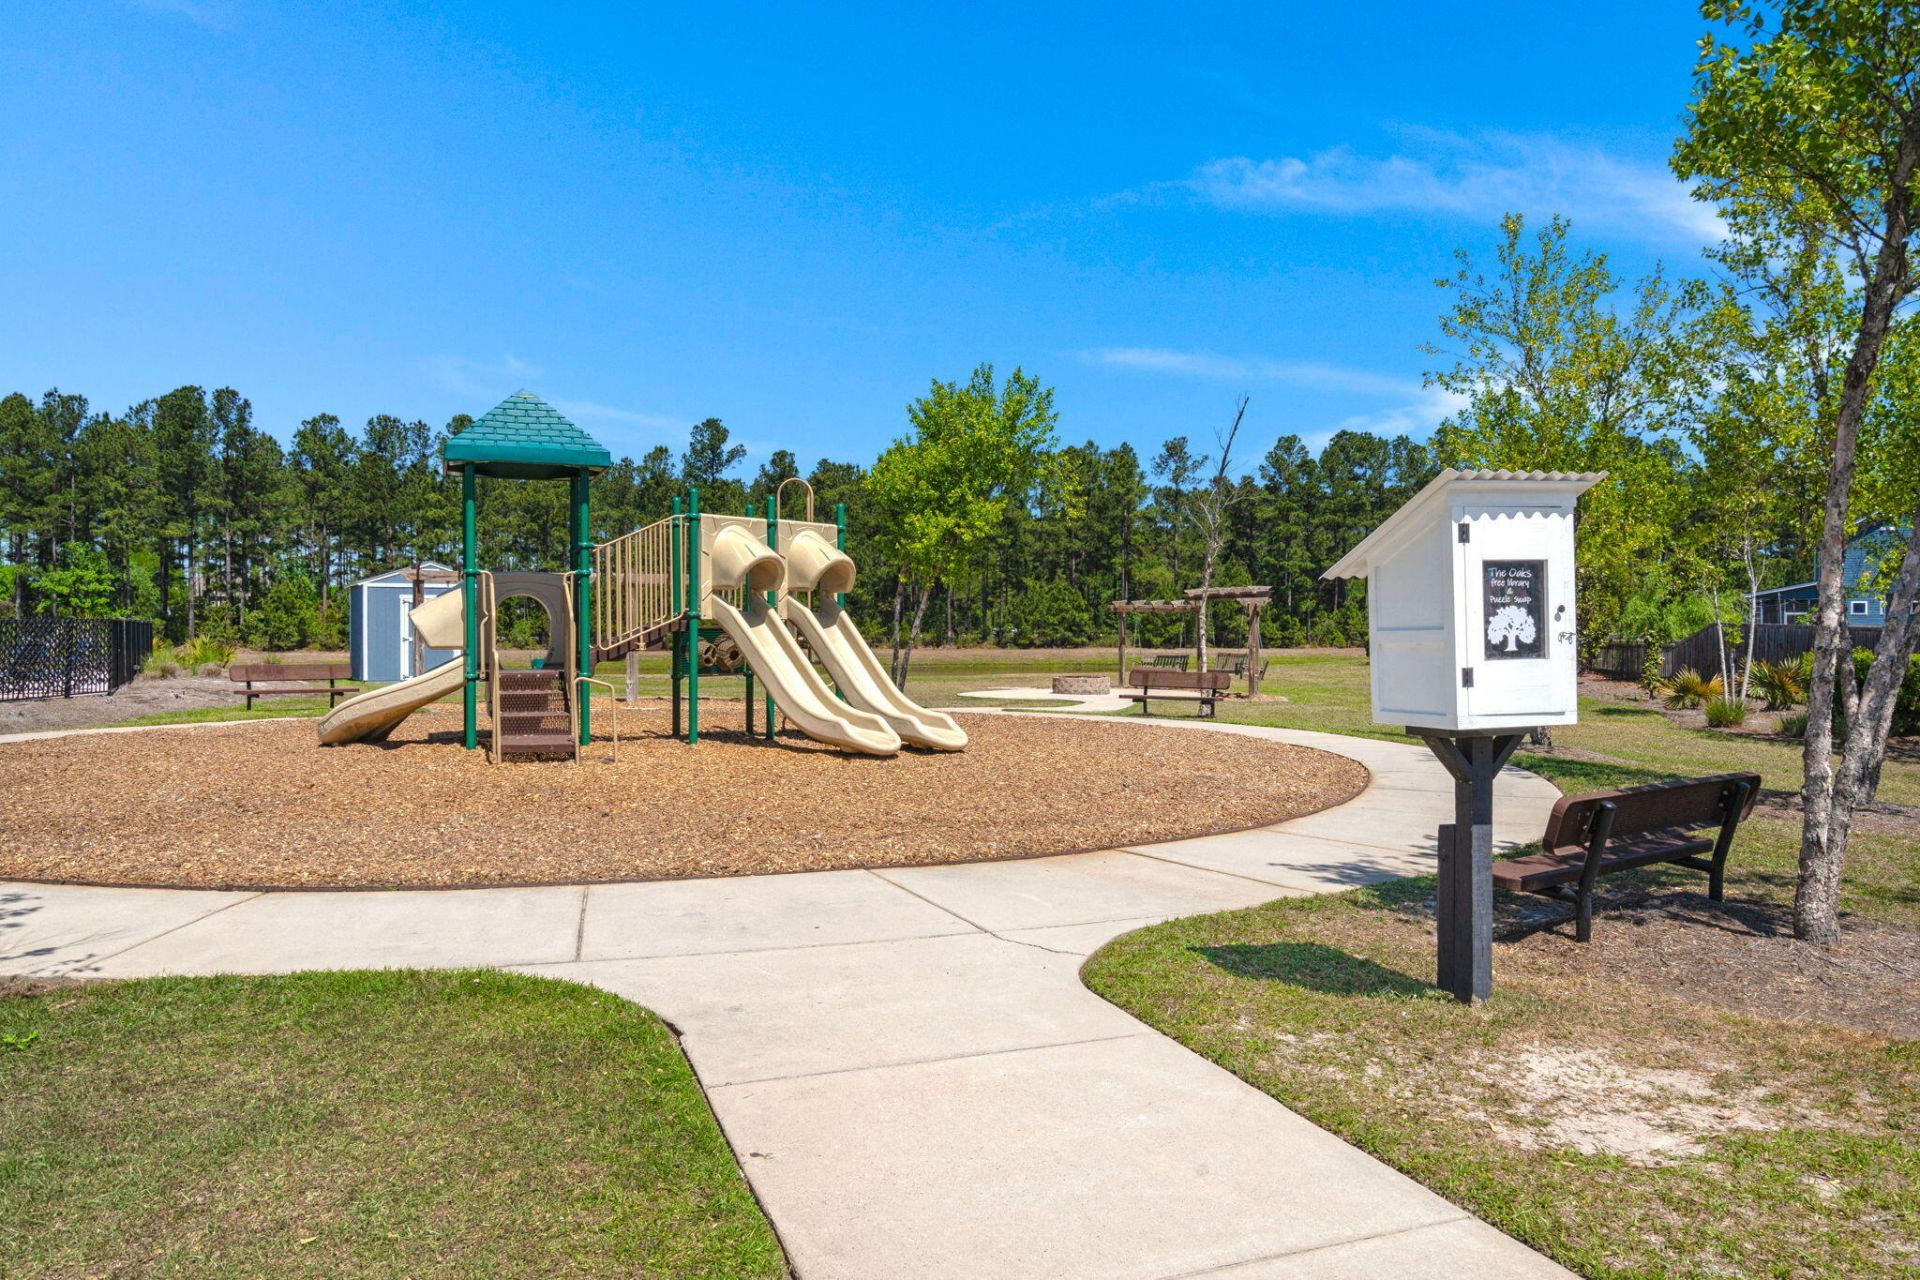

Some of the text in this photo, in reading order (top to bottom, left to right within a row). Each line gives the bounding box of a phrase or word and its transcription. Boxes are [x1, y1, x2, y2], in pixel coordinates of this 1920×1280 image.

[1488, 567, 1532, 577] The Oaks
[1506, 587, 1513, 595] &
